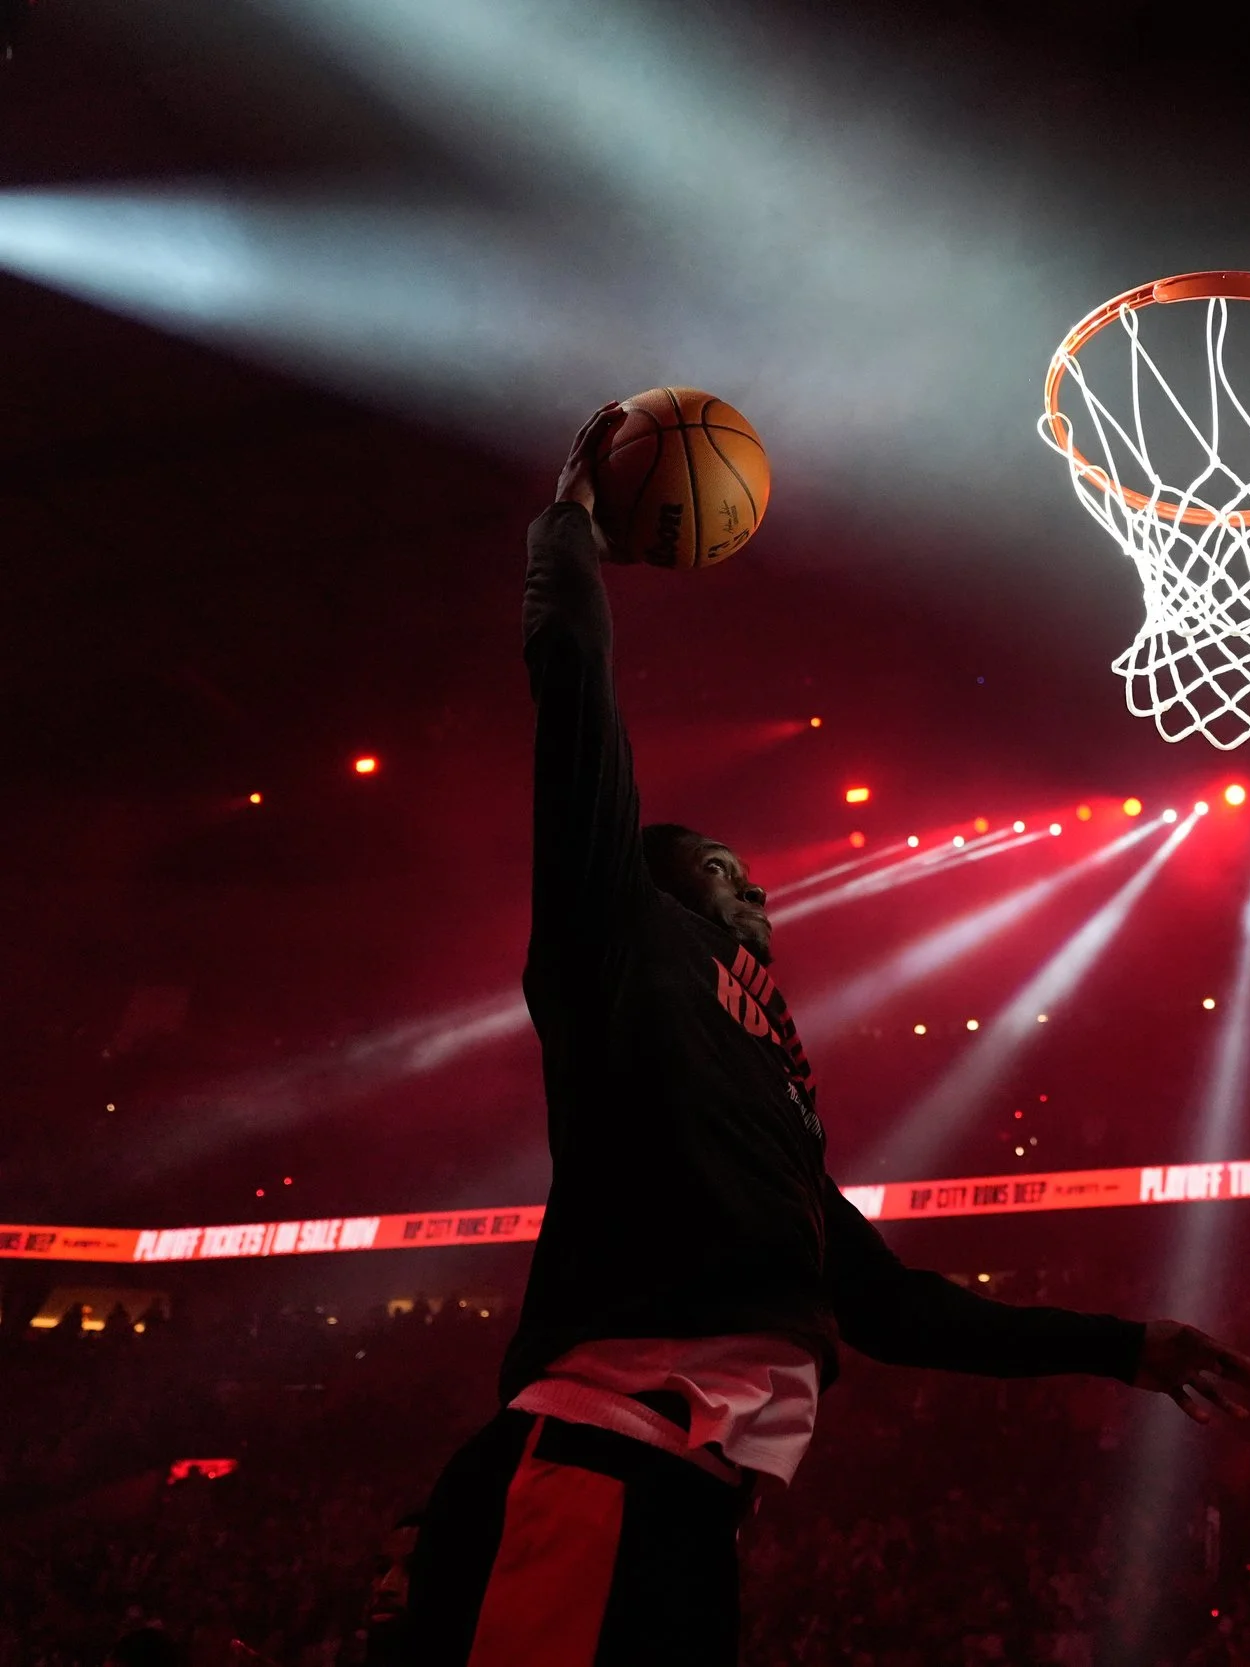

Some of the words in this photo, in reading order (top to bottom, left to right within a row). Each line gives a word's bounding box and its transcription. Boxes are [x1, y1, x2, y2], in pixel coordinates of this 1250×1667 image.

[910, 1188, 932, 1210] RIP
[936, 1186, 967, 1209] CITY
[1013, 1181, 1047, 1205] DEEP
[1140, 1163, 1223, 1203] PLAYOFF
